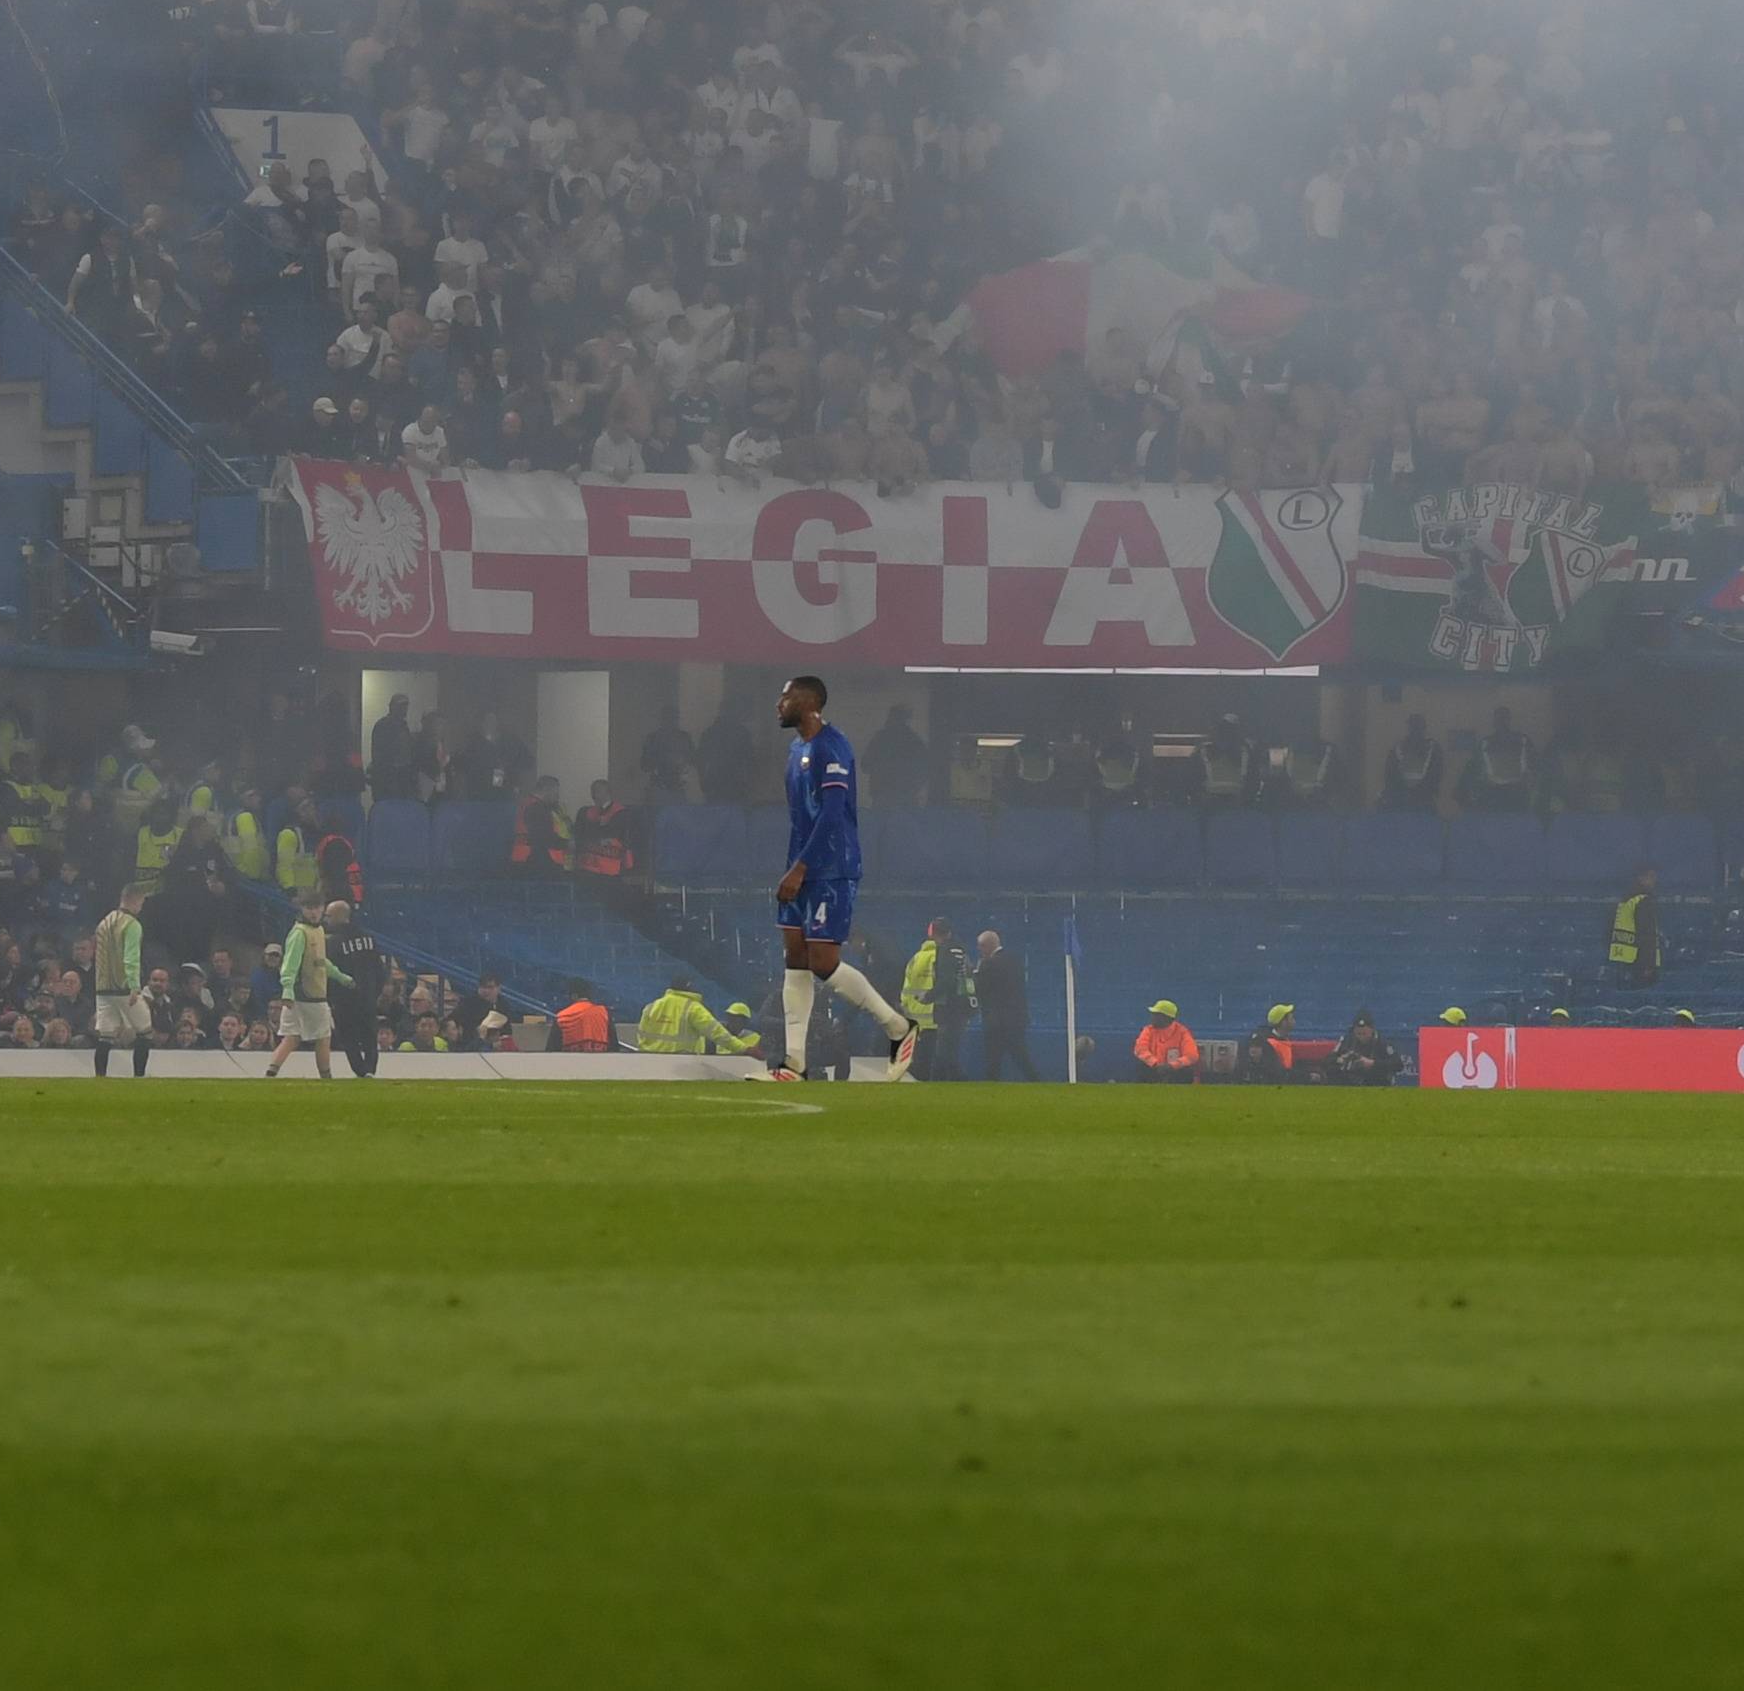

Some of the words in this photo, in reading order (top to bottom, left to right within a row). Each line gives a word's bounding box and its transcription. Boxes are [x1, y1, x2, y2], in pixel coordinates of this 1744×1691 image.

[262, 115, 287, 160] 1
[1411, 482, 1604, 540] CAPITAL
[426, 477, 1197, 646] LEGIA
[1429, 615, 1553, 673] CITY
[814, 901, 827, 924] 4
